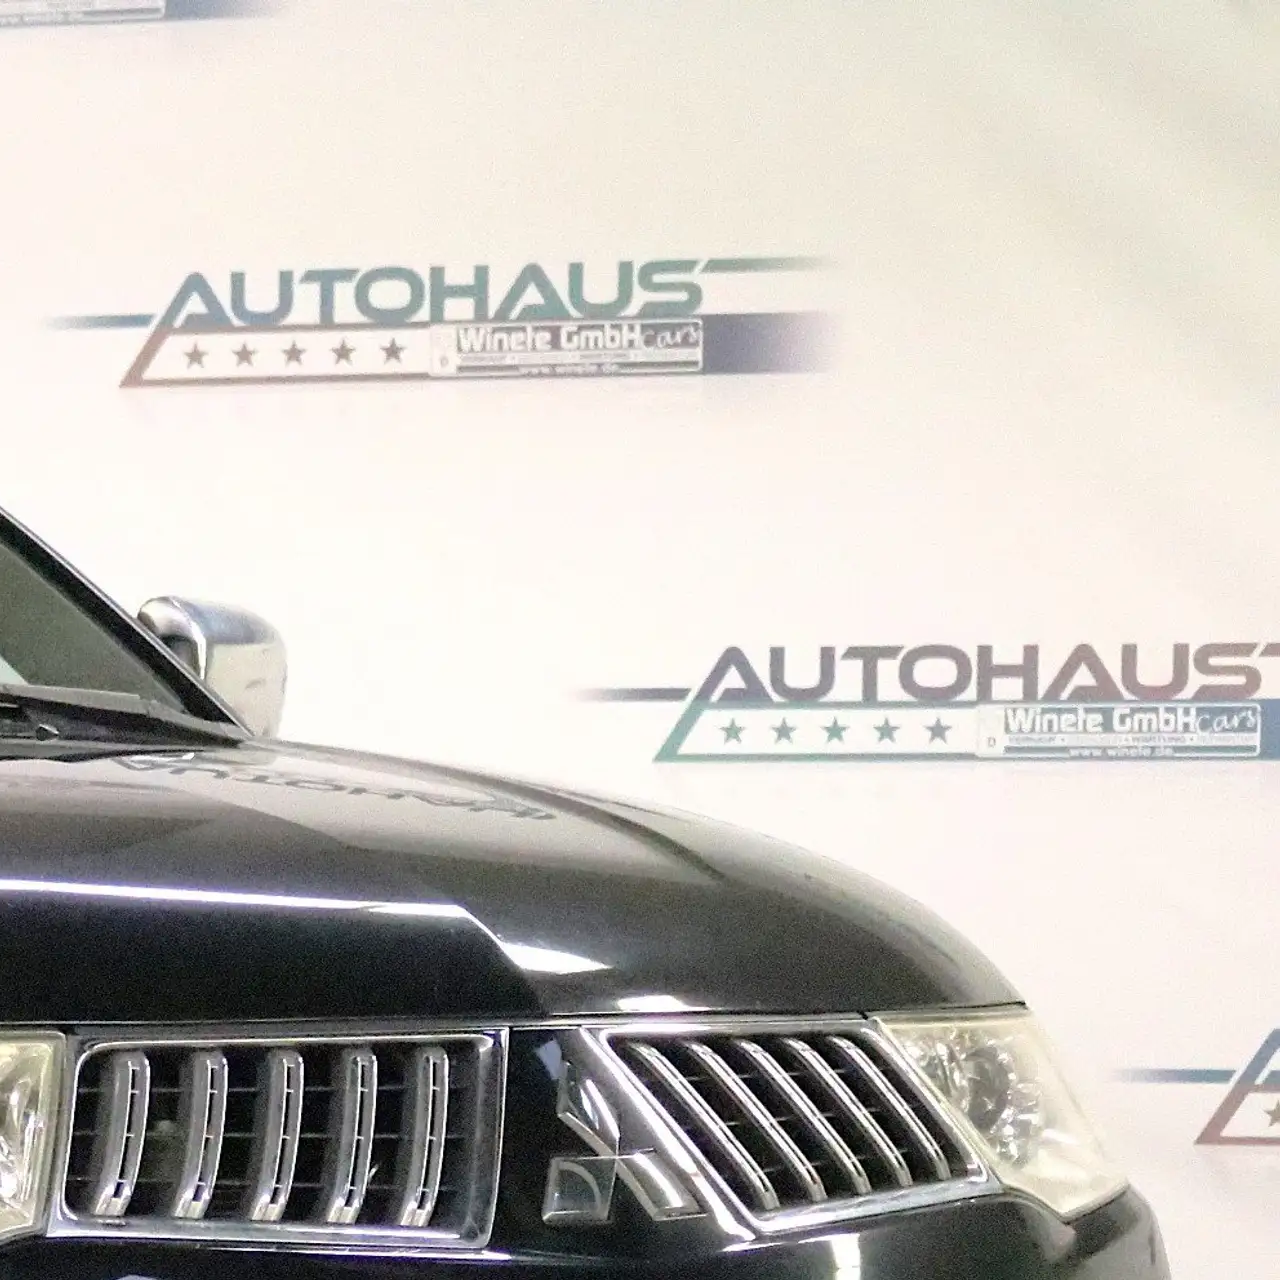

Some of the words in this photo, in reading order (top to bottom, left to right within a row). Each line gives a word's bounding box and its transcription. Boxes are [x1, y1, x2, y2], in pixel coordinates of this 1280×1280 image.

[156, 259, 704, 330] AUTOHAUS
[559, 322, 640, 350] GmbH
[690, 643, 1263, 702] AUTOHAUS
[1006, 705, 1104, 733] Winete
[1112, 705, 1197, 733] GmbH
